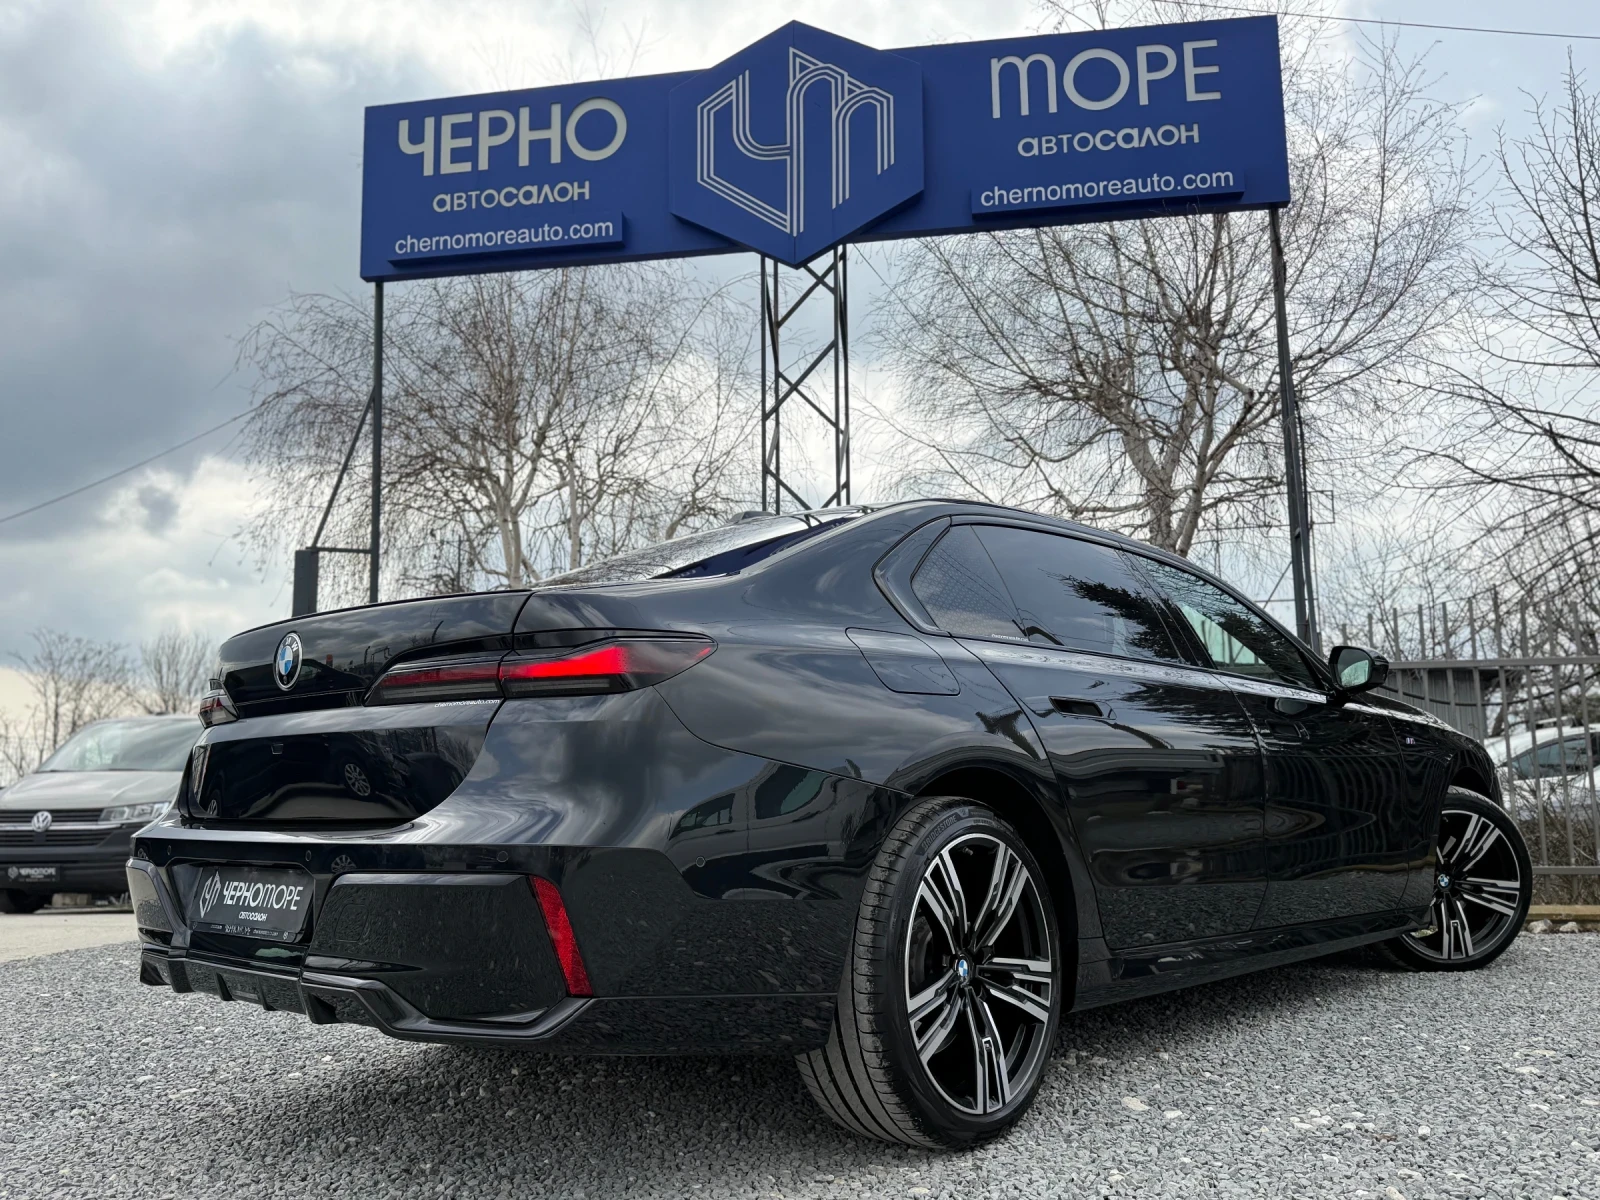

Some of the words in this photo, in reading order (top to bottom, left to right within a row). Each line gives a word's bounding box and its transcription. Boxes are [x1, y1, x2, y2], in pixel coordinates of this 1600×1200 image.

[991, 39, 1221, 118] МОРЕ
[399, 97, 627, 176] ЧЕРНО
[981, 171, 1233, 206] chernomoreauto.com
[395, 221, 613, 254] chernomoreauto.com
[223, 880, 304, 911] ЧЕРНОМОРЕ
